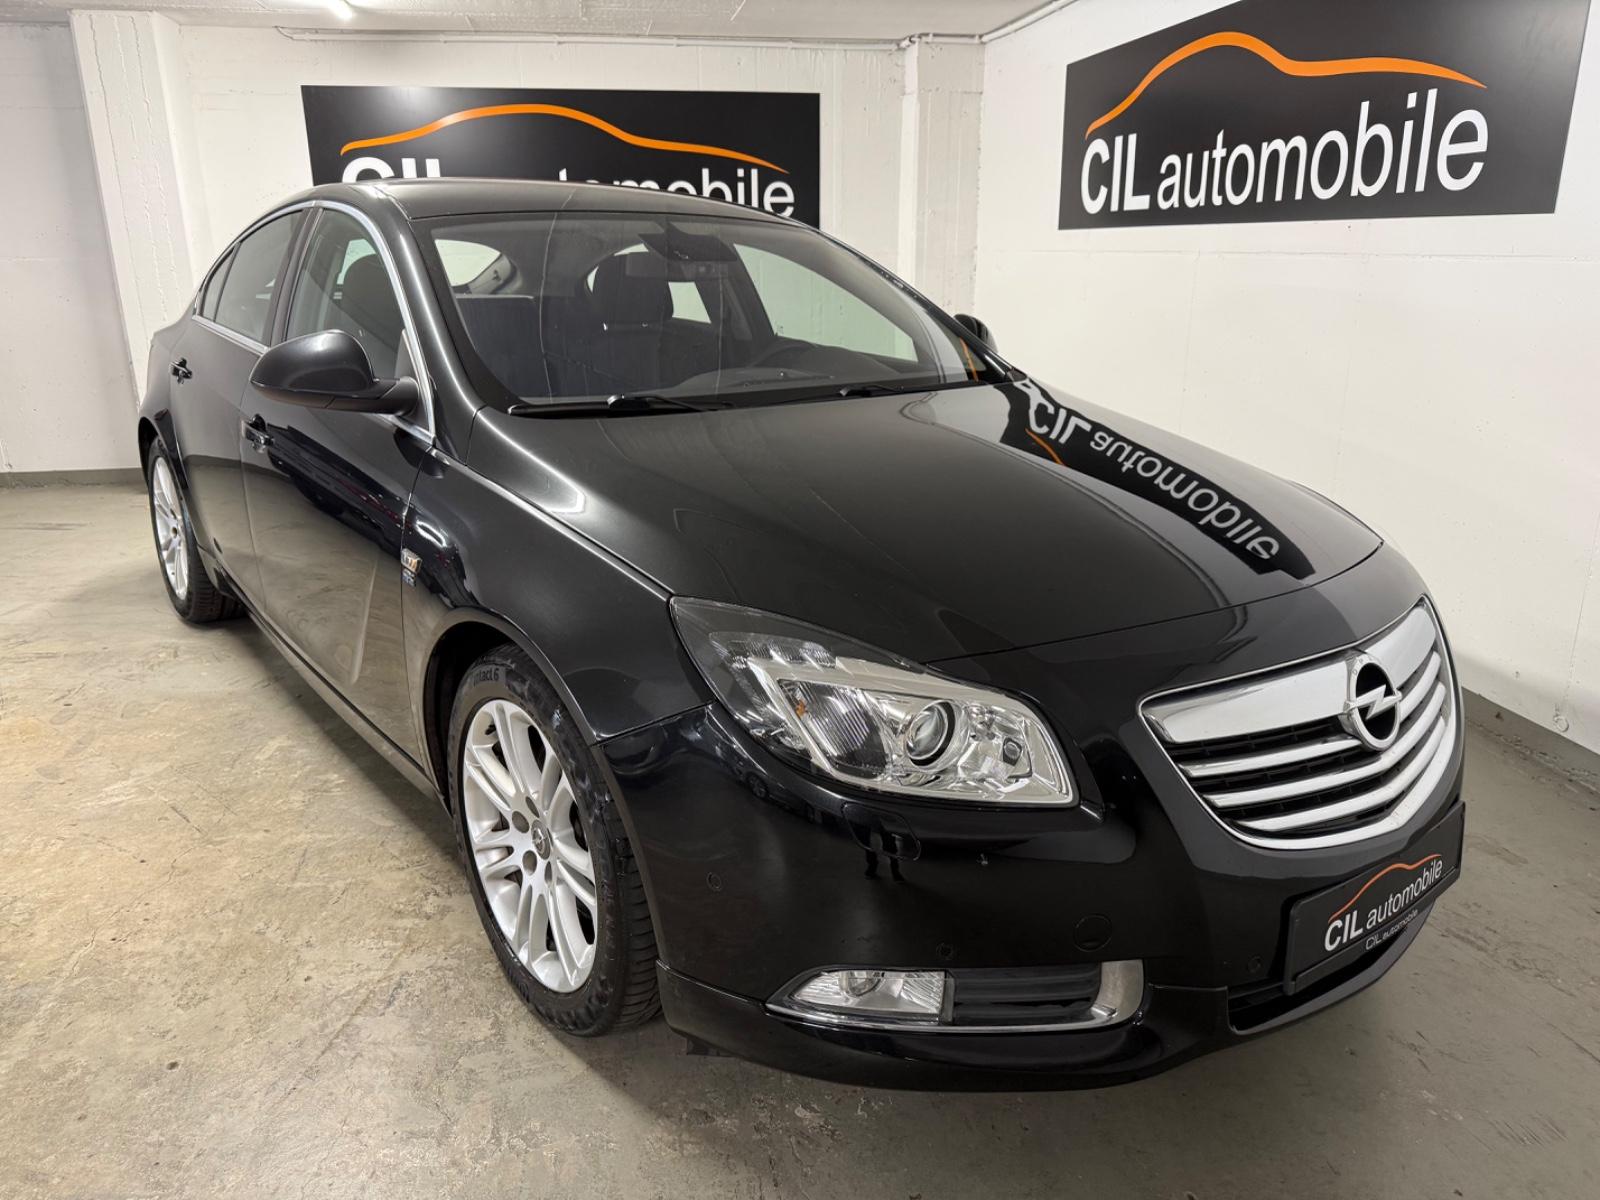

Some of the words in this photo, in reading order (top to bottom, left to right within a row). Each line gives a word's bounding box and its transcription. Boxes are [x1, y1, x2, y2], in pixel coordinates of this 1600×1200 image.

[1081, 133, 1150, 214] CIL
[1157, 88, 1489, 210] automobile
[1324, 910, 1363, 951] CIL
[1366, 859, 1443, 930] automobile
[1365, 934, 1382, 951] CIL
